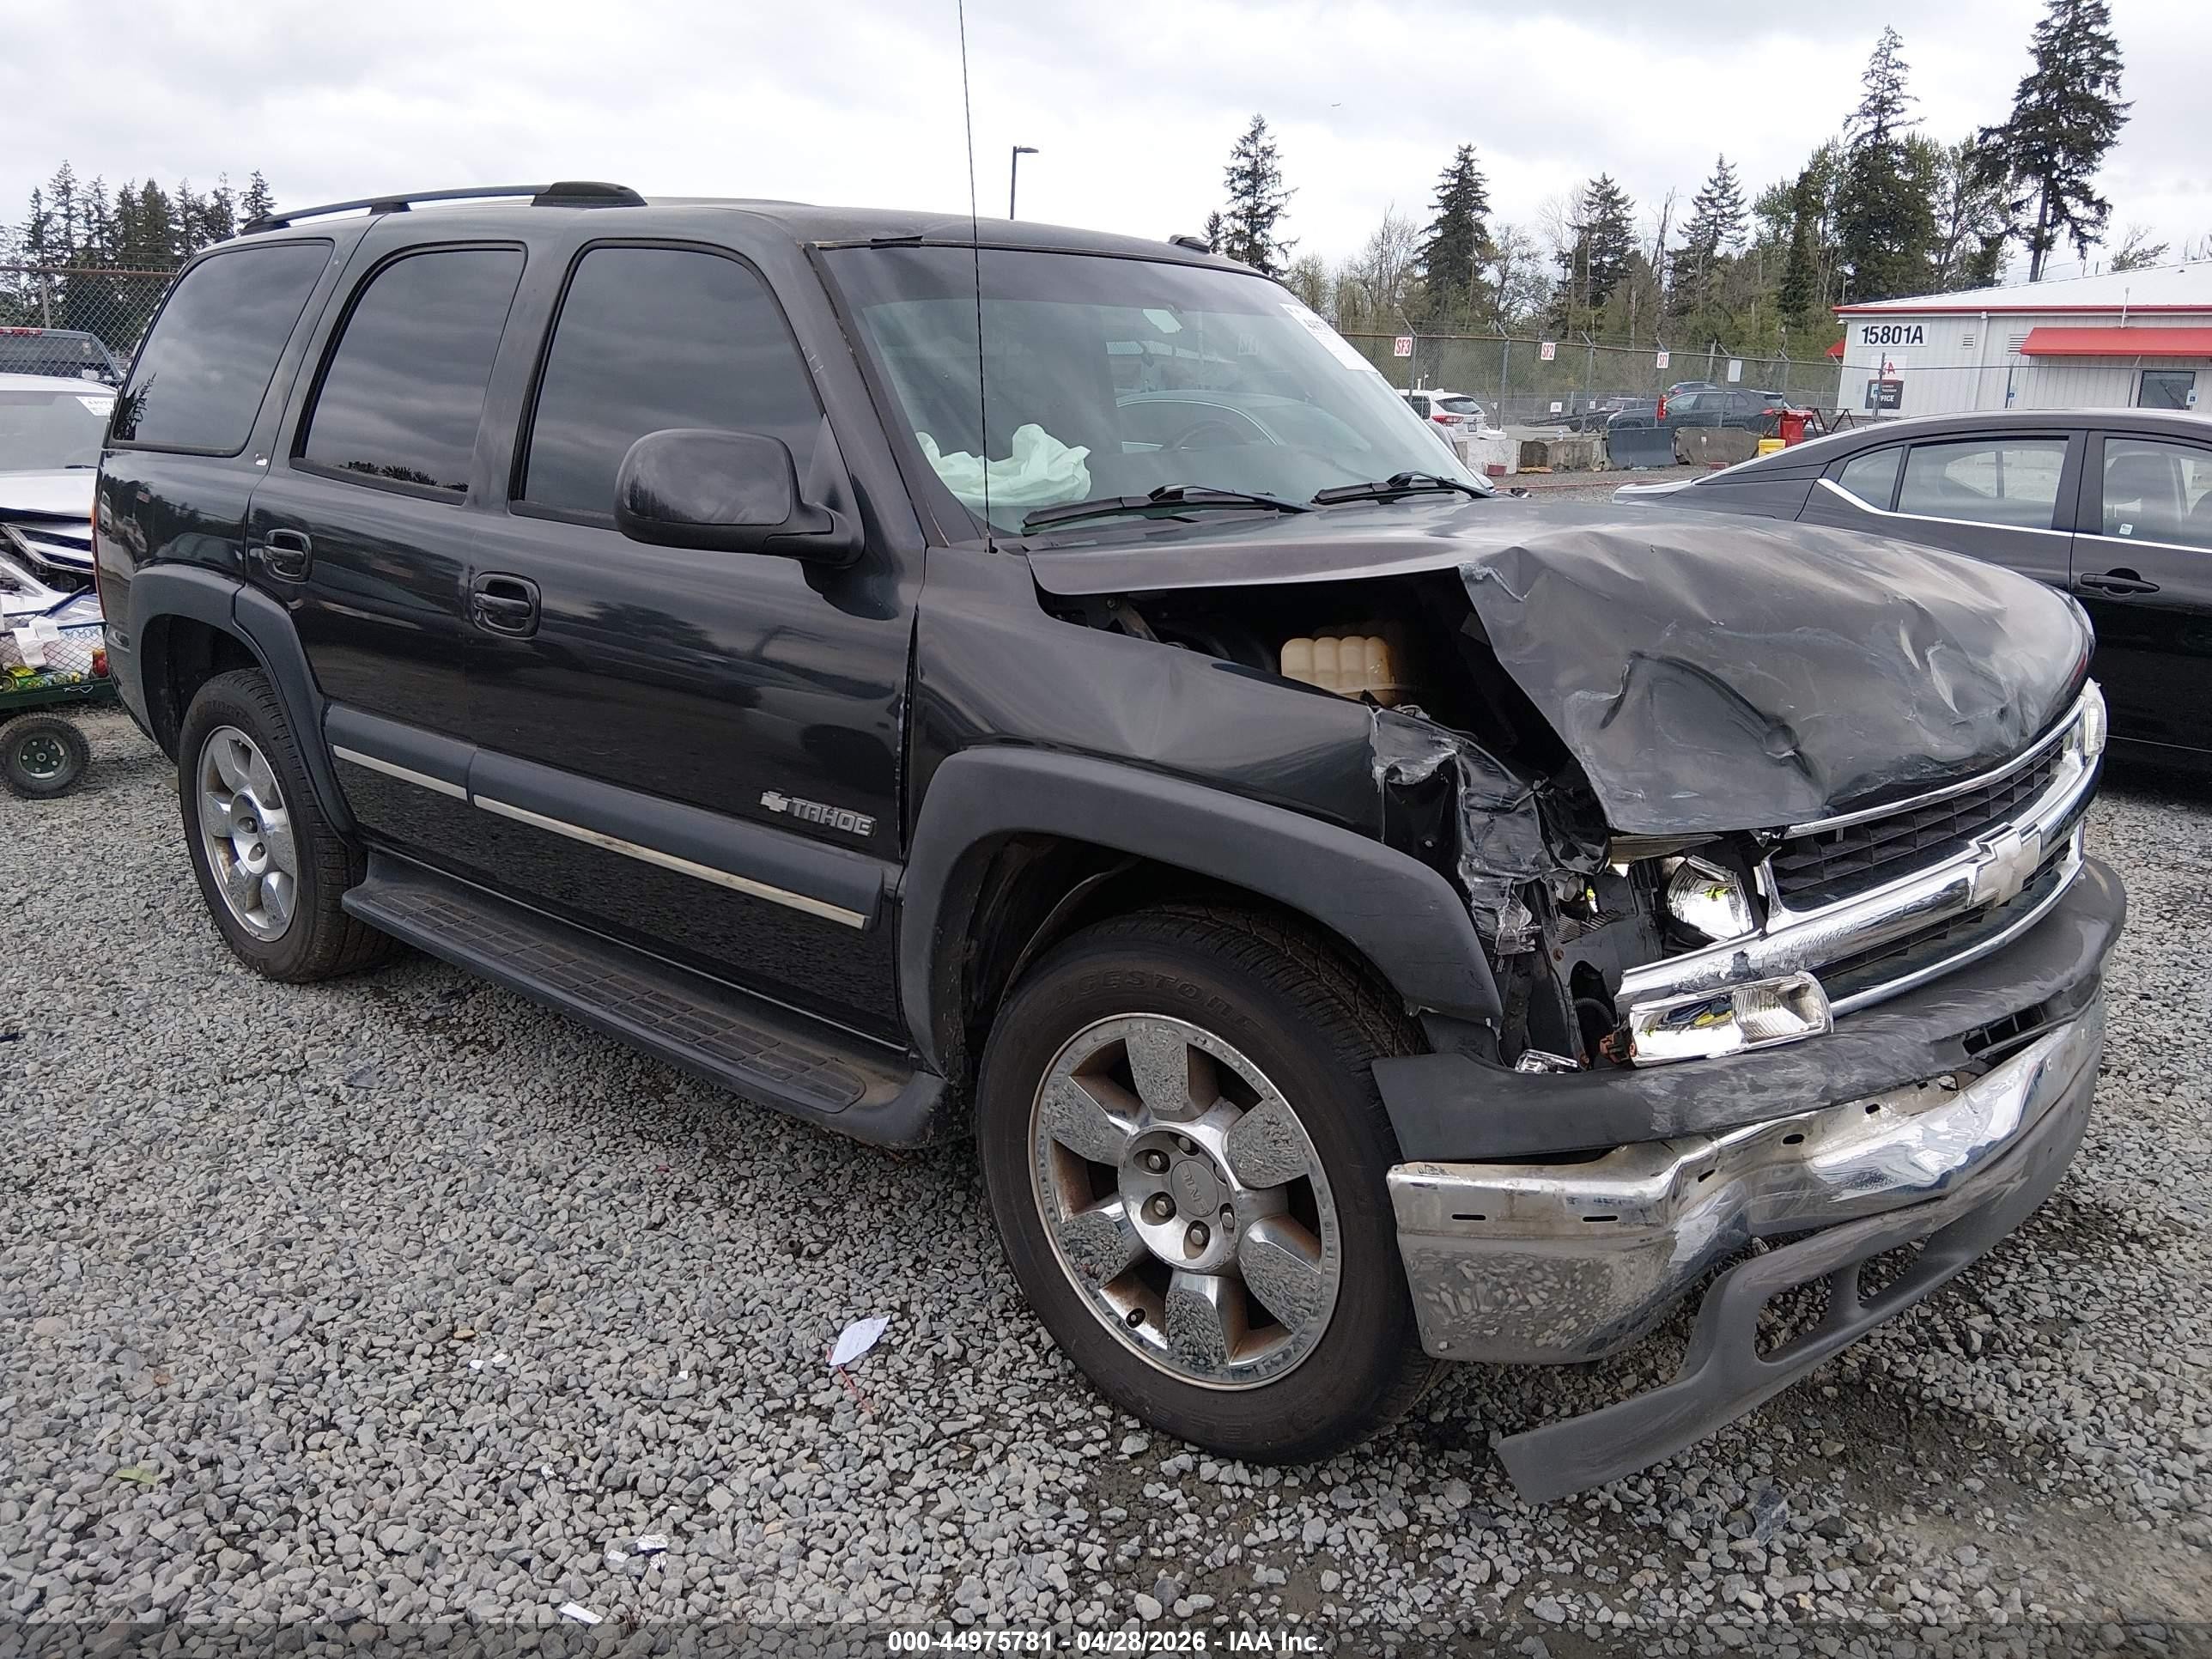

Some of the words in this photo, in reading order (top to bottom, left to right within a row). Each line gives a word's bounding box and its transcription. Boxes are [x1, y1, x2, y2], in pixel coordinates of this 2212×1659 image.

[1861, 325, 1924, 345] 15801A
[1395, 338, 1412, 355] SF3
[1541, 344, 1554, 359] SF2
[1658, 354, 1668, 368] SF1
[792, 799, 875, 836] TAHOE
